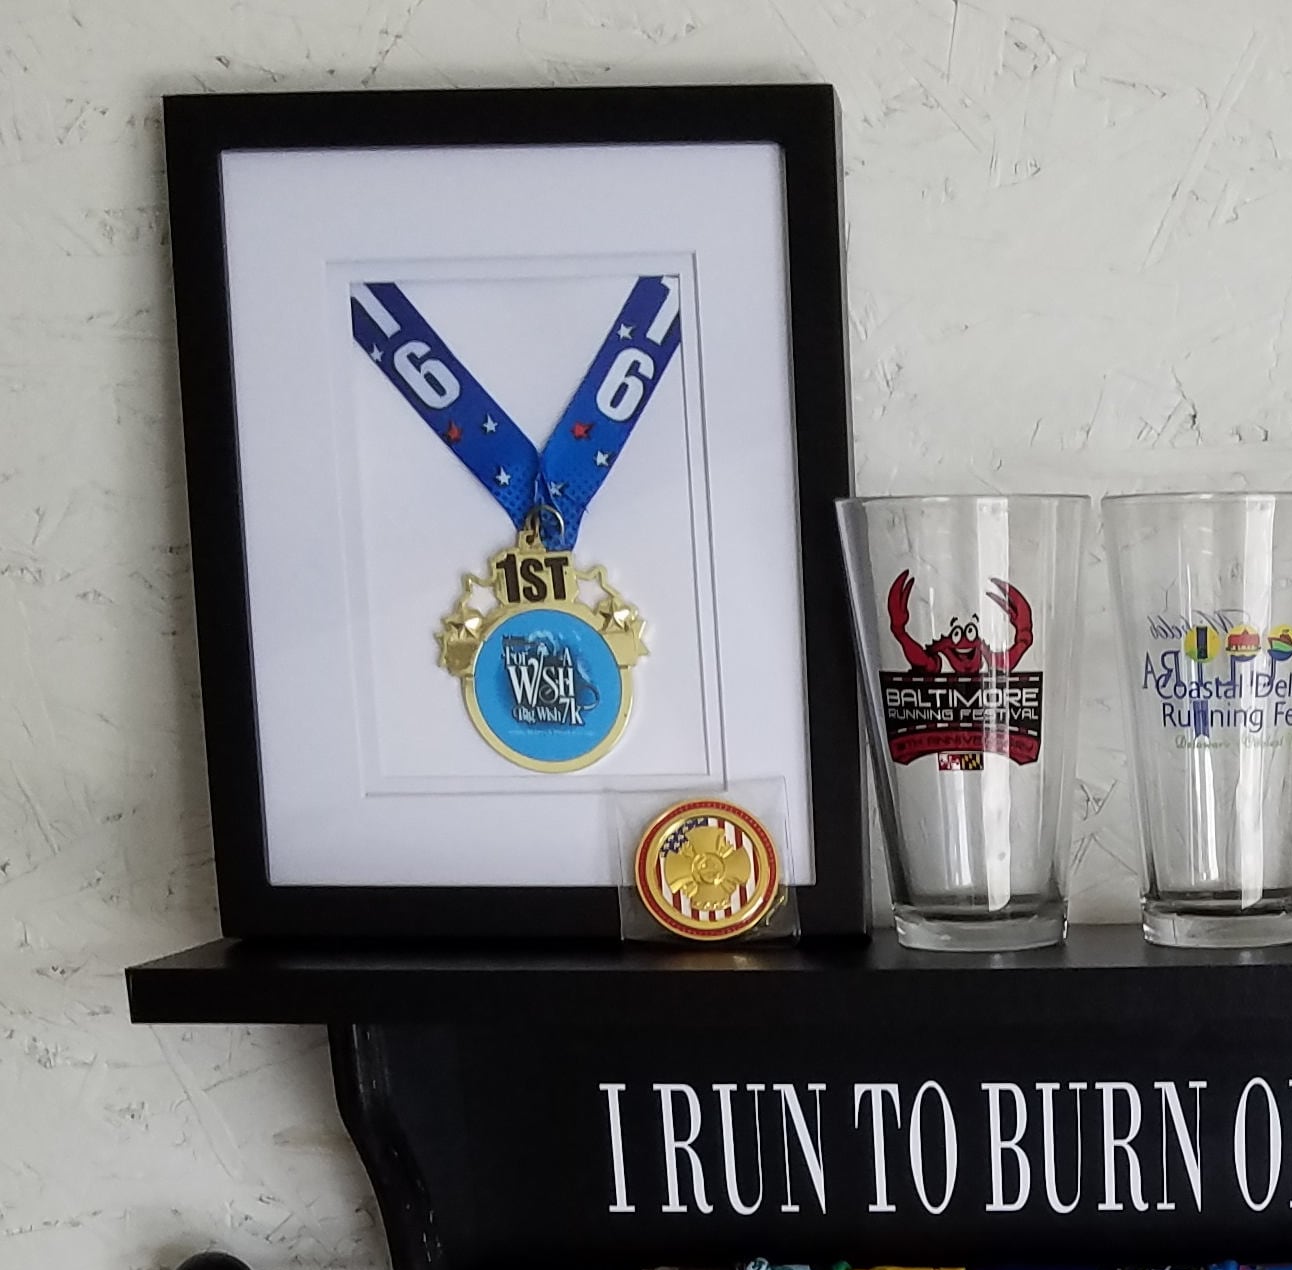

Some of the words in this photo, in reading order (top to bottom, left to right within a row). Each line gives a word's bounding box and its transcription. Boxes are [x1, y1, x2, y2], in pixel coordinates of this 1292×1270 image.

[496, 554, 568, 603] 1ST
[886, 688, 1039, 708] BALTIMORE
[1156, 671, 1243, 700] Coastal
[888, 708, 953, 721] RUNNING
[960, 708, 1039, 721] FESTIVAL
[1162, 702, 1264, 733] Running
[600, 1083, 636, 1213] I
[652, 1082, 827, 1216] RUN
[854, 1080, 958, 1216] TO
[980, 1080, 1208, 1215] BURN
